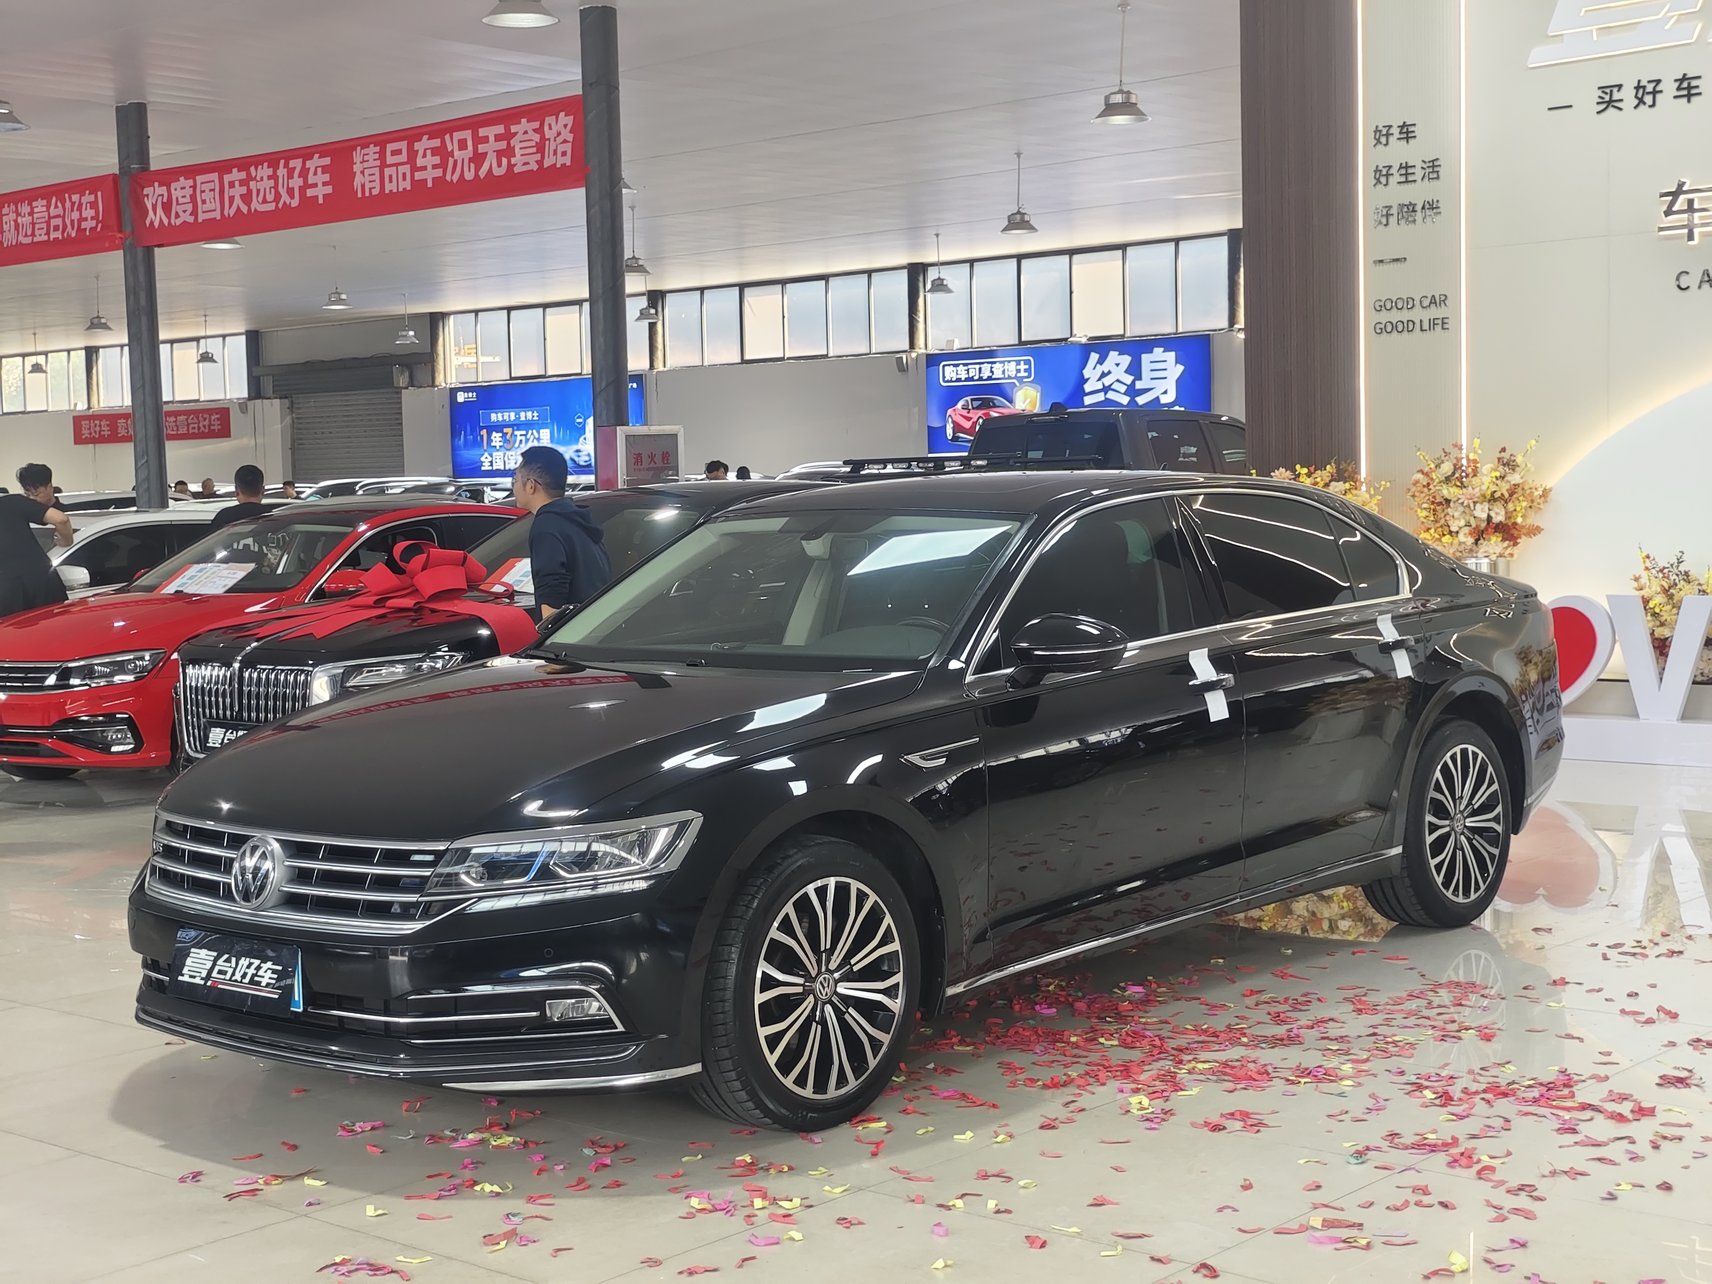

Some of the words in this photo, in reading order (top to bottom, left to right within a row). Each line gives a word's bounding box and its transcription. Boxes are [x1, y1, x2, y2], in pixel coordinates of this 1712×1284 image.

[1596, 73, 1702, 114] 买好车
[1373, 121, 1417, 147] 好车
[143, 153, 333, 229] 欢度国庆选好车
[352, 112, 574, 198] 精品车况无套路
[1373, 158, 1442, 187] 好生活
[1373, 199, 1442, 228] 好陪伴
[1373, 297, 1415, 312] GOOD
[1419, 294, 1448, 310] CAR
[1373, 319, 1416, 335] GOOD
[1419, 316, 1450, 333] LIFE
[944, 360, 1029, 381] 购车可享查博士
[1082, 347, 1185, 406] 终身
[81, 418, 111, 438] 买好车
[633, 451, 671, 466] 消火栓
[178, 947, 283, 987] 壹台好车
